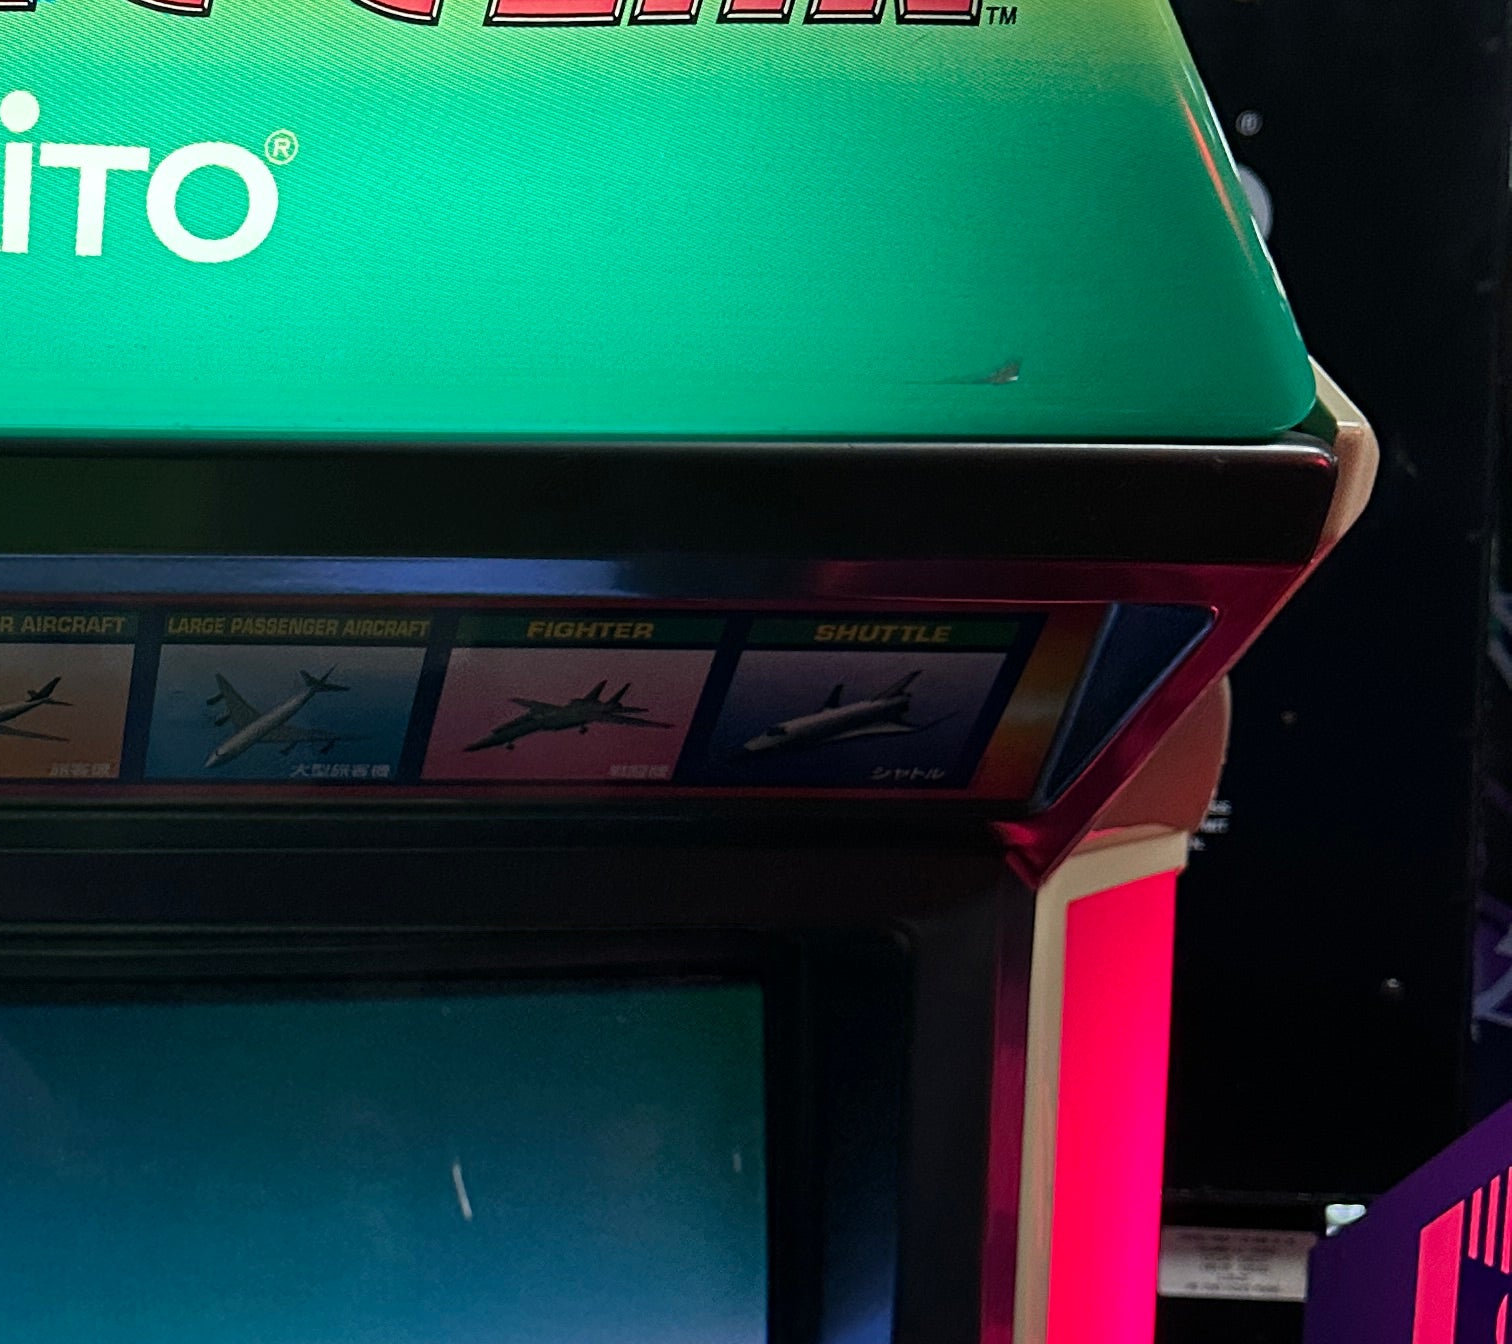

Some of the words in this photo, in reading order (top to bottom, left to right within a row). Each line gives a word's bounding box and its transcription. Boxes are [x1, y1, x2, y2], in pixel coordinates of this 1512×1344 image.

[21, 616, 127, 634] AIRCRAFT
[167, 616, 224, 635] LARGE
[230, 617, 339, 636] PASSENGER
[342, 619, 431, 638] AIRCRAFT
[526, 620, 655, 640] FIGHTER
[814, 624, 952, 644] SHUTTLE
